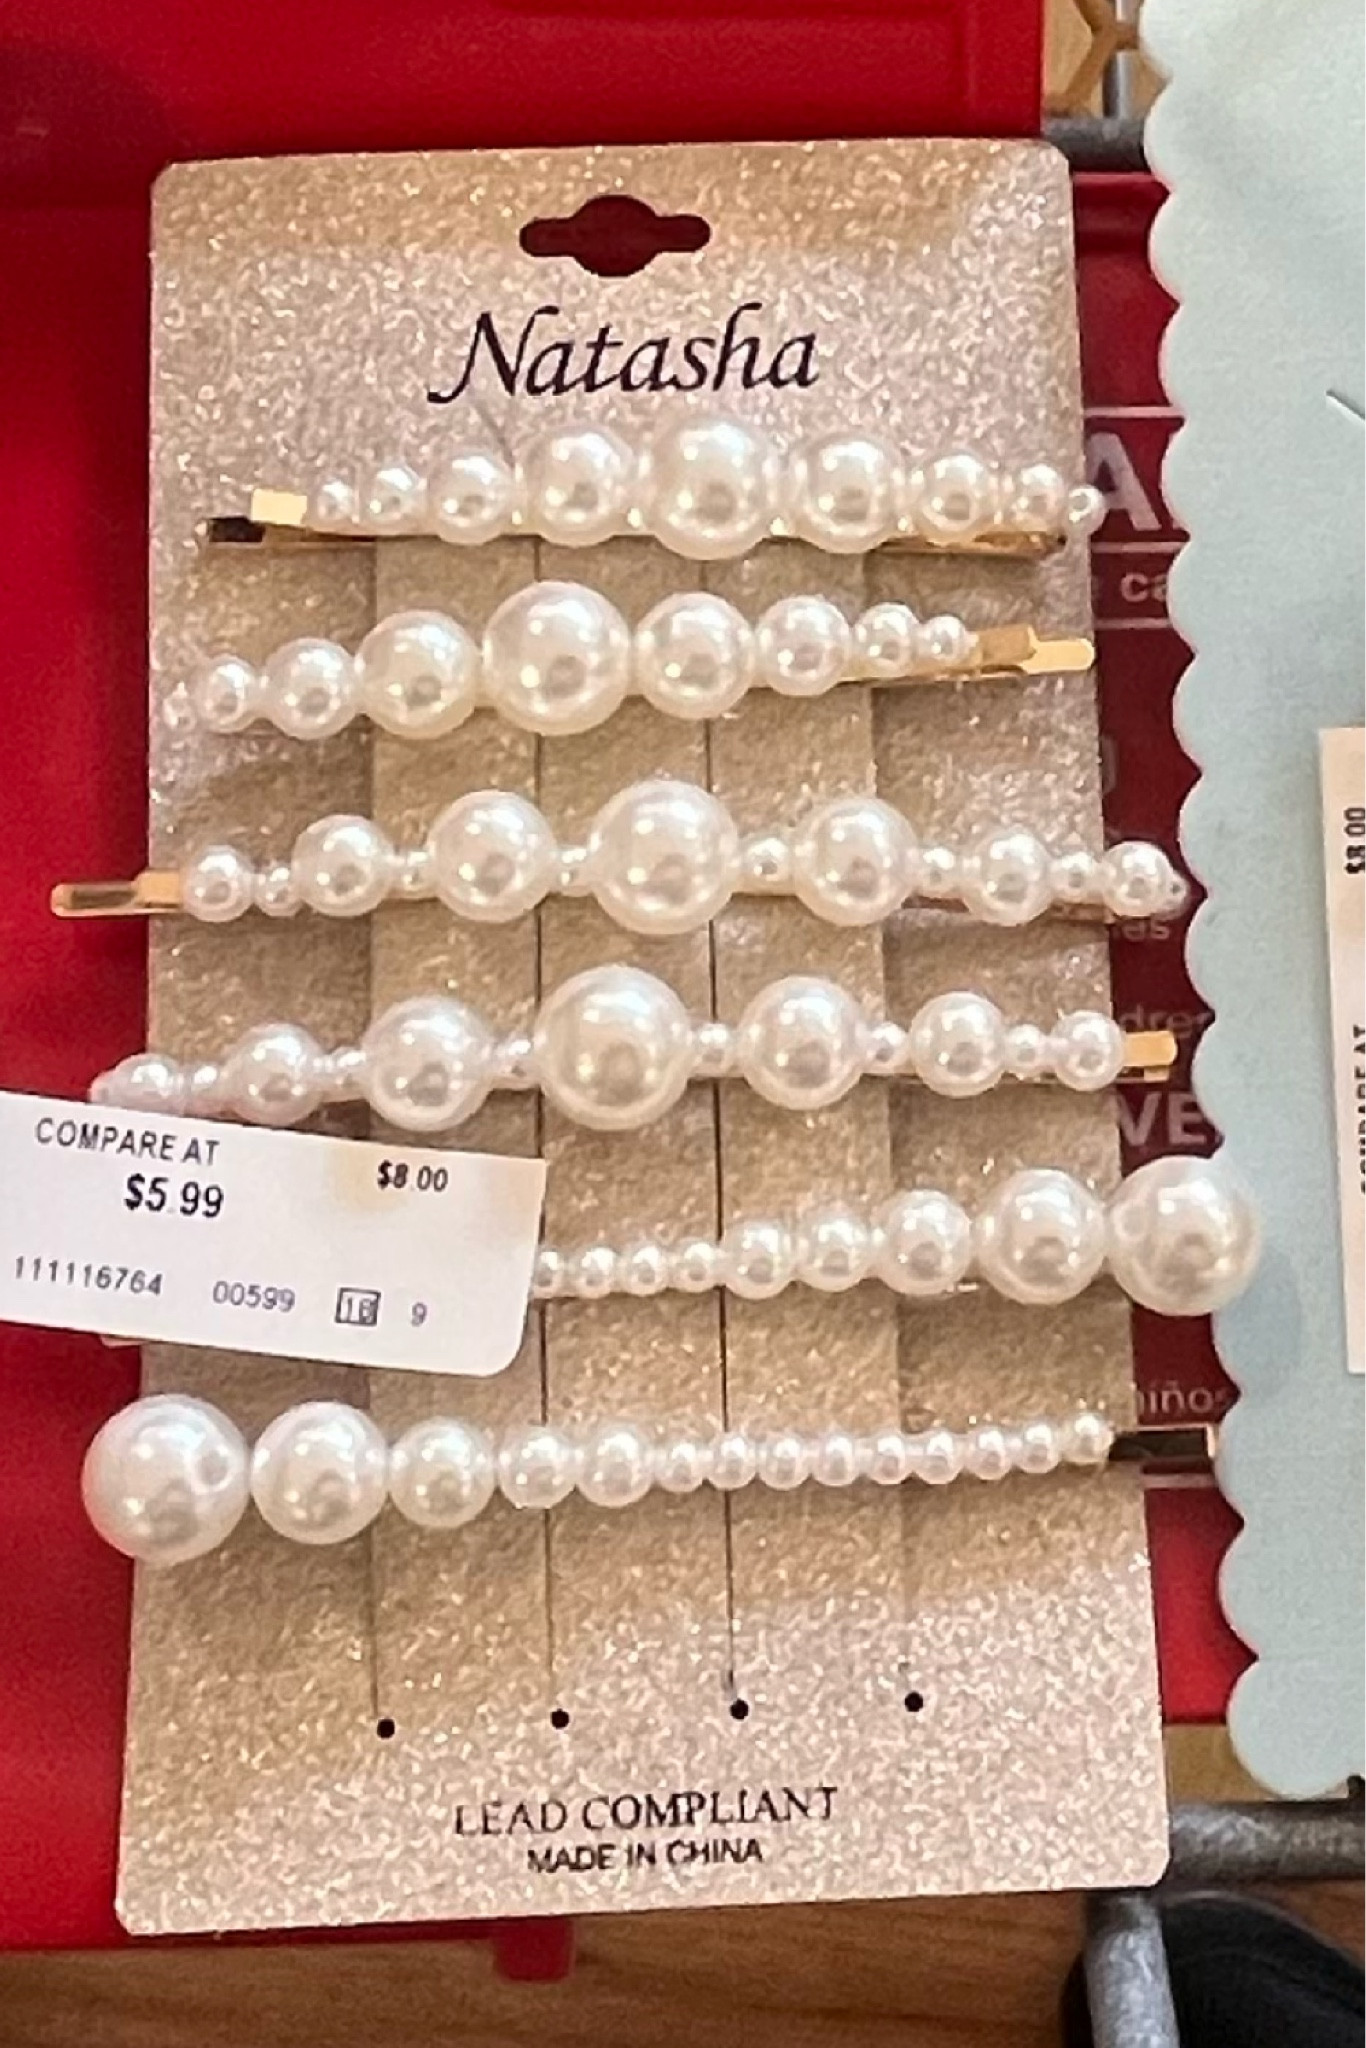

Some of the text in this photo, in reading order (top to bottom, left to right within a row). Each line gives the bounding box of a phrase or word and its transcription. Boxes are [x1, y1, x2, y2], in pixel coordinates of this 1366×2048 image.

[427, 301, 820, 404] Natasha
[35, 1117, 449, 1193] COMPARE AT $8.00
[124, 1173, 225, 1219] $5.99
[14, 1255, 163, 1297] 111116764
[212, 1280, 297, 1313] 00599
[410, 1301, 428, 1327] 9
[455, 1785, 838, 1836] LEAD COMPLIANT
[527, 1838, 764, 1874] MADE IN CHINA
